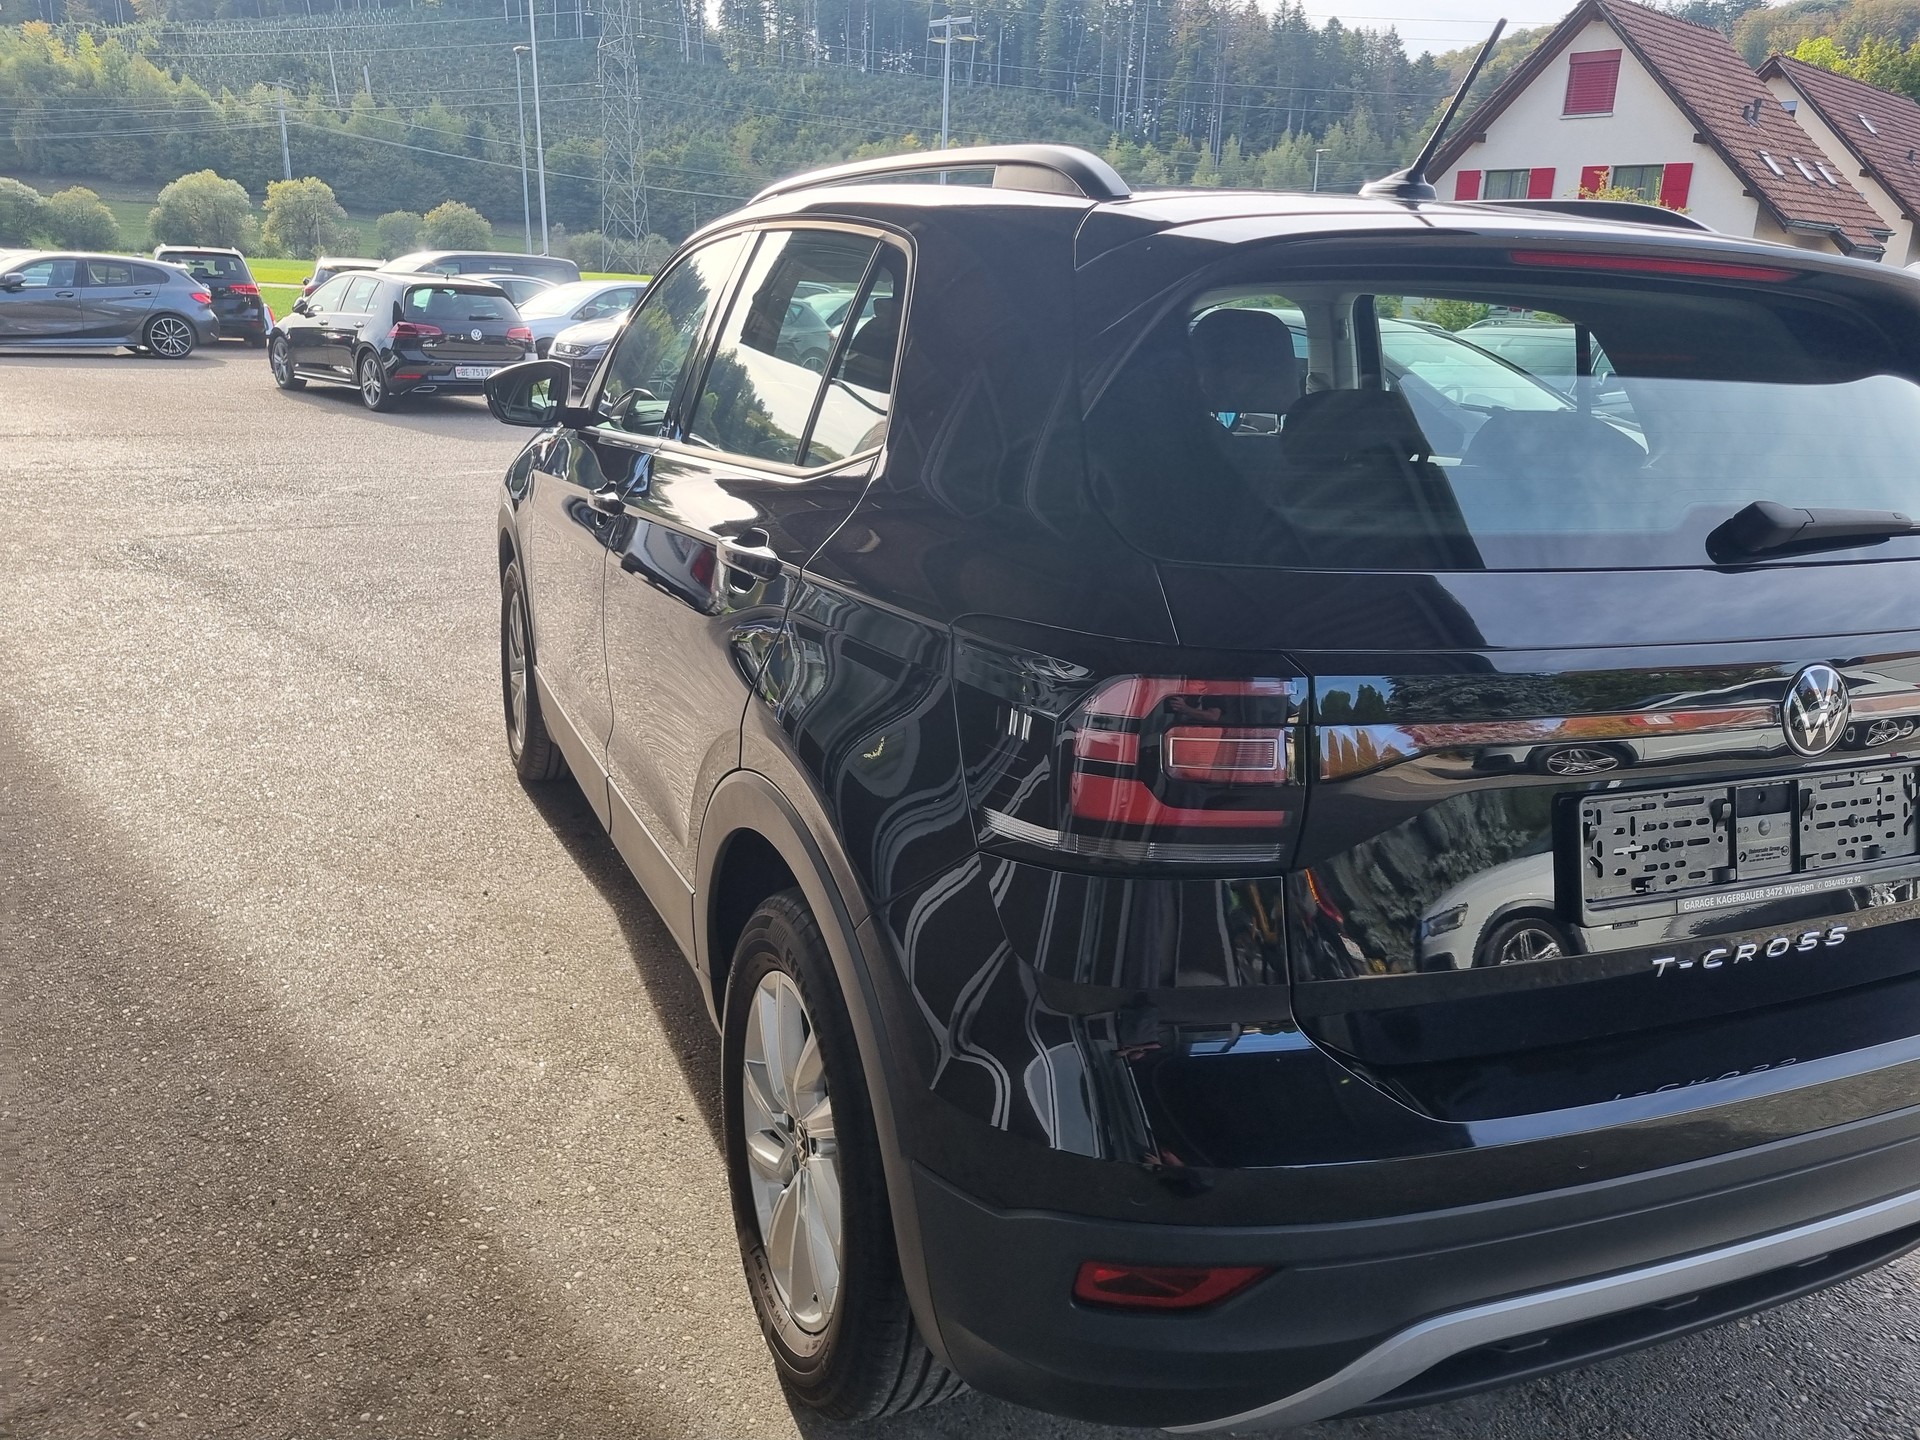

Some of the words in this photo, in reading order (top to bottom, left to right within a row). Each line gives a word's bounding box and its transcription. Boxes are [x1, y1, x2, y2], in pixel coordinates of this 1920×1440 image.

[1683, 897, 1714, 911] GARAGE
[1716, 890, 1765, 905] KAGERBAUER
[1766, 886, 1783, 898] 3472
[1784, 882, 1814, 895] Wynigen
[1824, 879, 1846, 888] 034/415
[1846, 877, 1853, 885] 22
[1854, 875, 1862, 883] 92
[1652, 926, 1848, 978] T-CROSS
